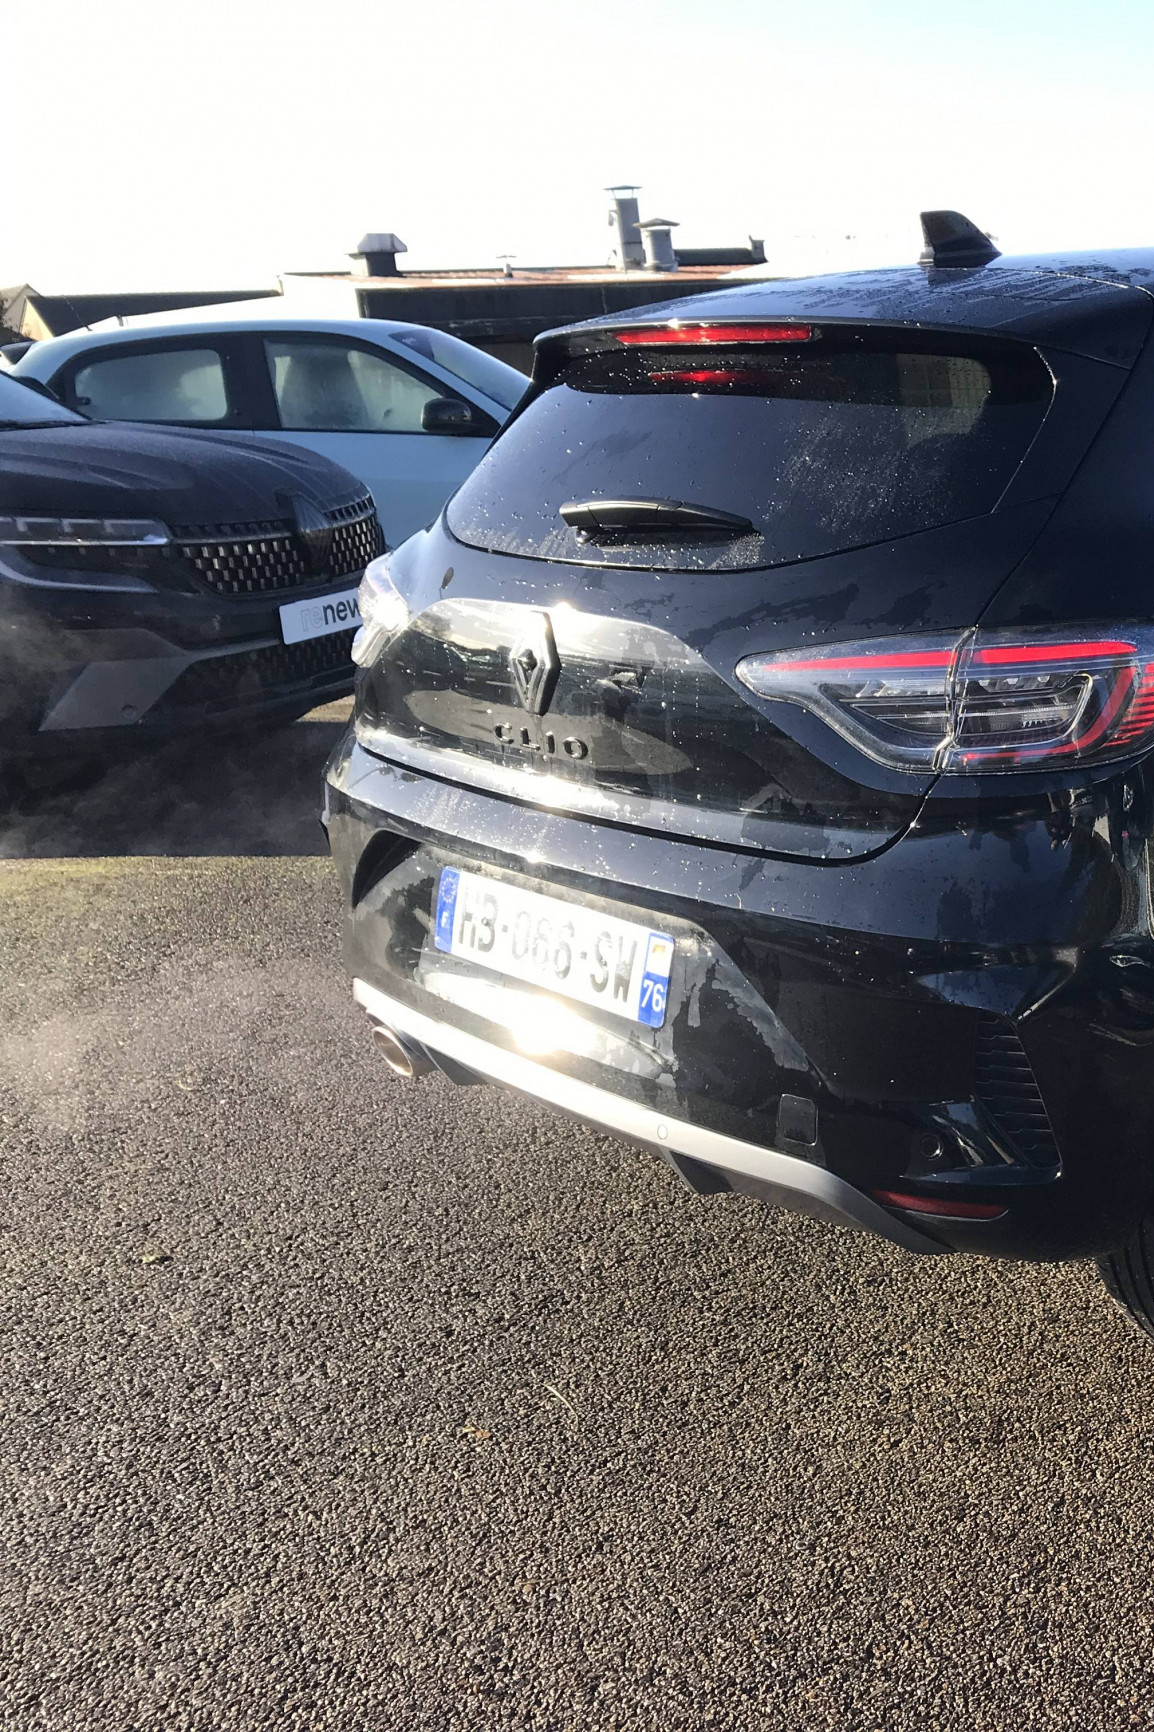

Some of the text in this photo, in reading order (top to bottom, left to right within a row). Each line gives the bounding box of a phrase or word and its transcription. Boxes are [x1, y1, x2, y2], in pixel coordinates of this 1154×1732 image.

[494, 723, 588, 760] CLIO
[441, 887, 665, 1012] F HB-066-SW 76
